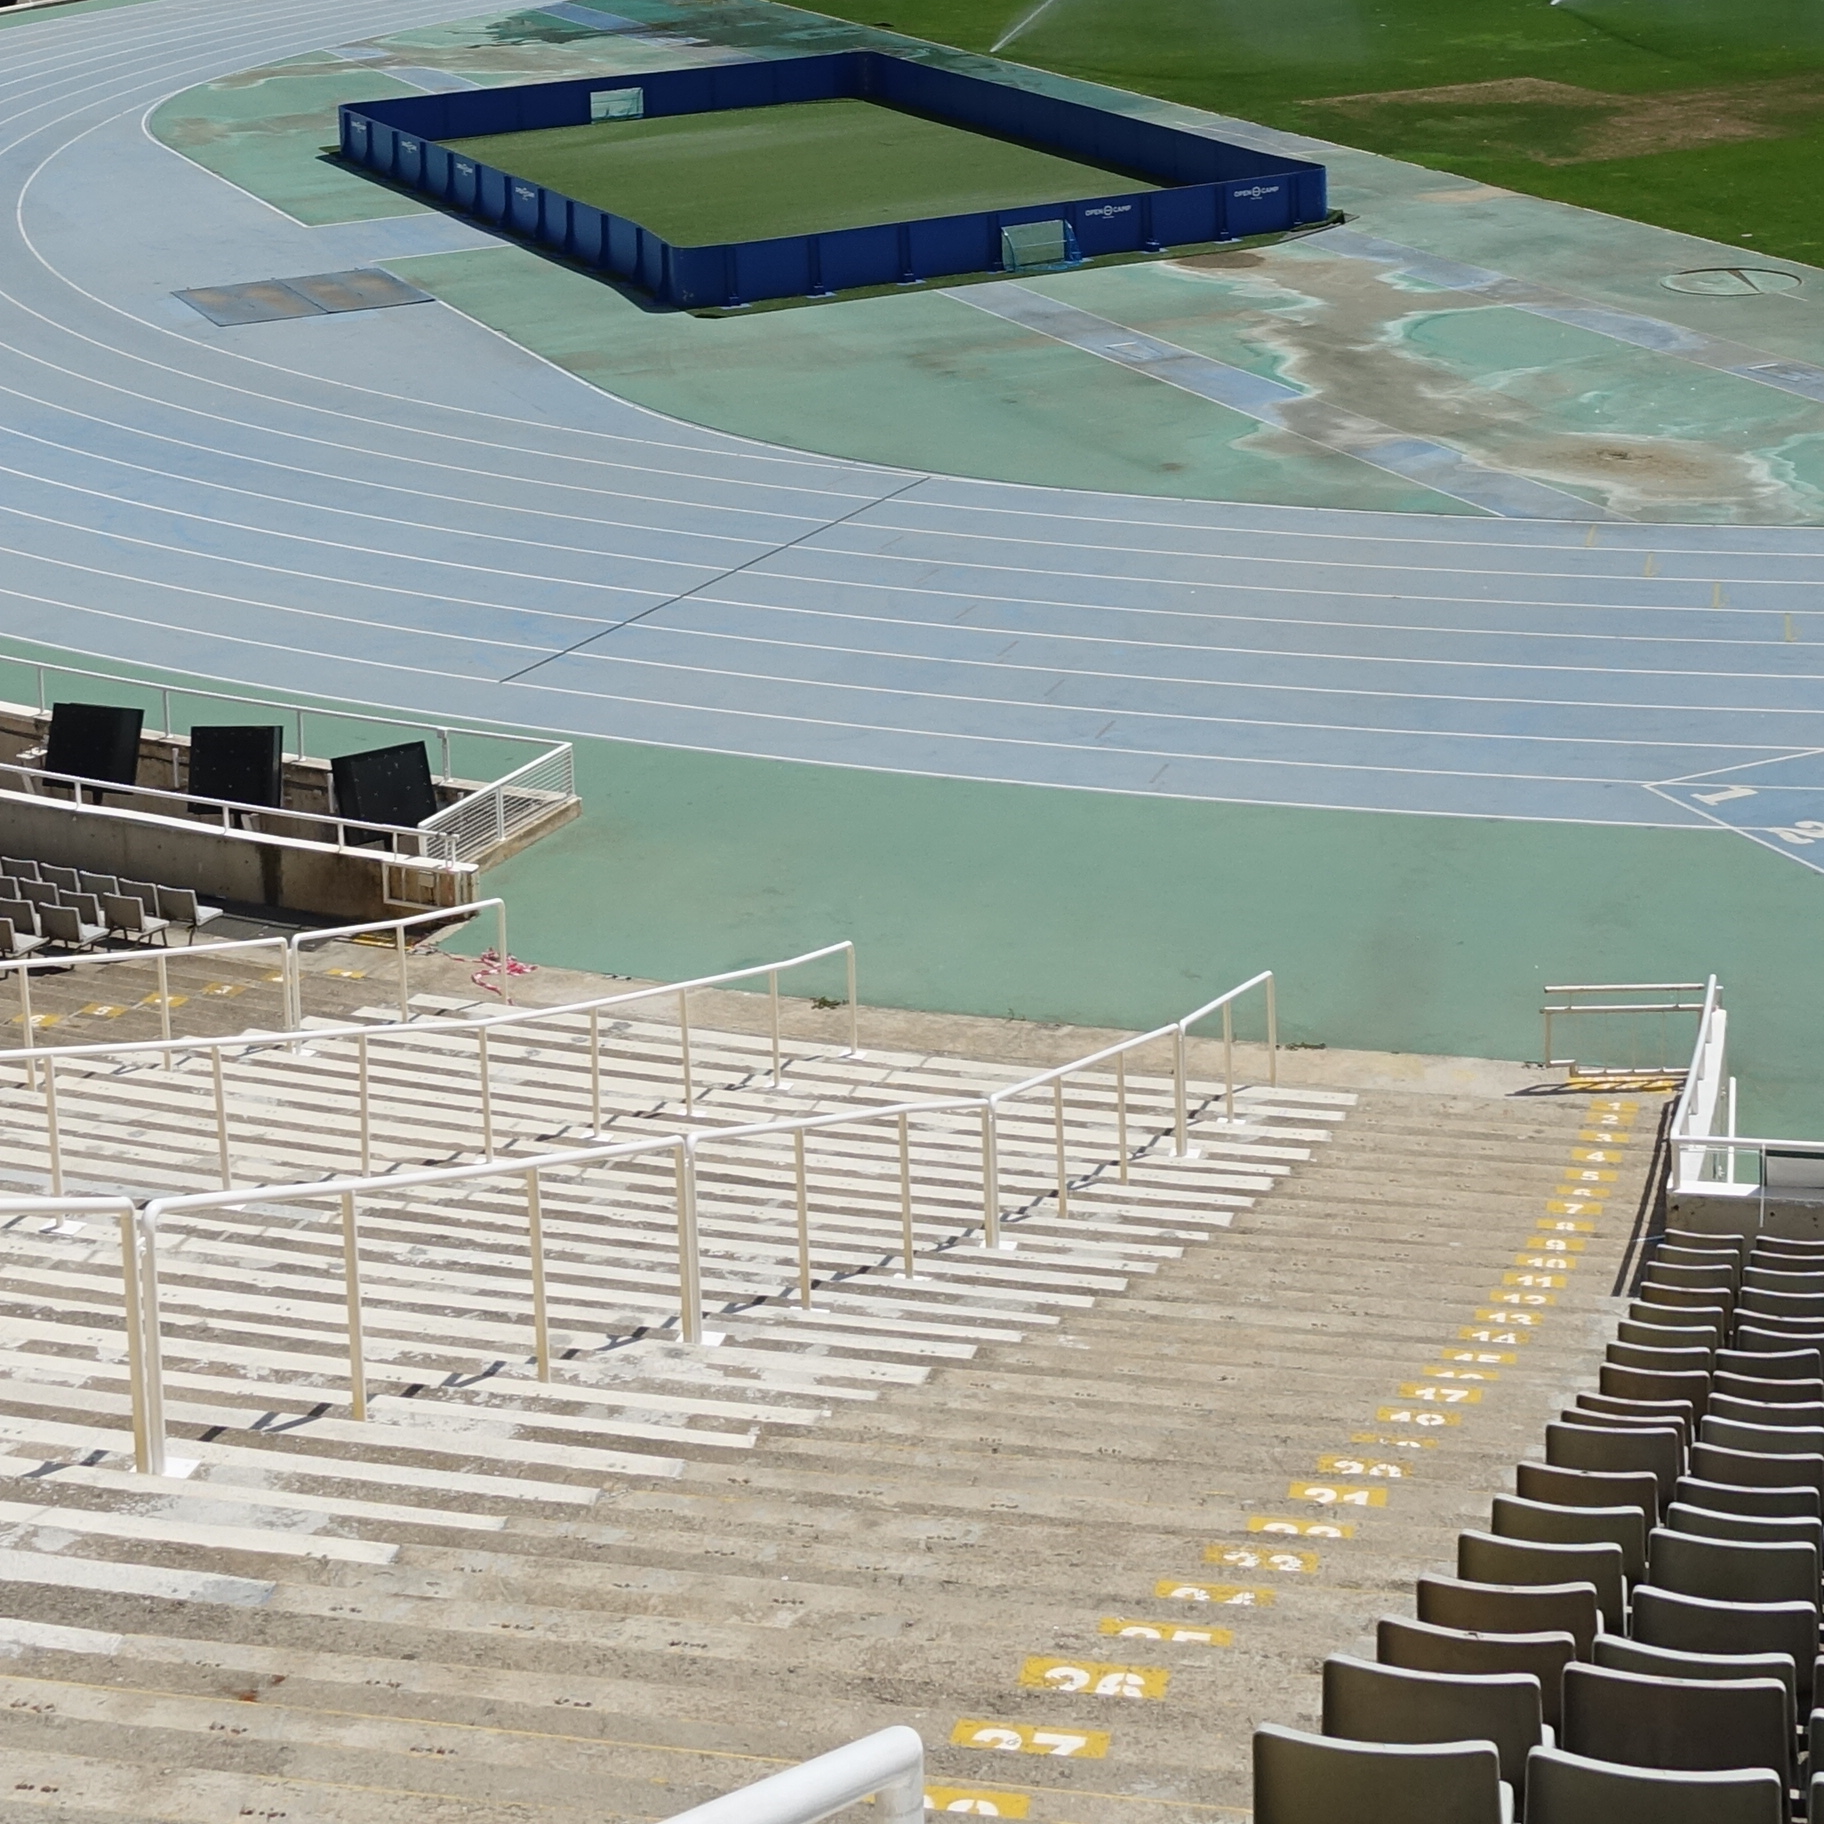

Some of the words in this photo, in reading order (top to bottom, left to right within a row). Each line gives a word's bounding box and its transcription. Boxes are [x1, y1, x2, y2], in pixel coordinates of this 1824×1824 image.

[1690, 785, 1758, 806] 1
[1608, 1102, 1621, 1111] 1
[1601, 1114, 1619, 1125] 2
[1586, 1151, 1606, 1162] 4
[1579, 1170, 1600, 1181] 5
[1564, 1203, 1584, 1214] 7
[1545, 1239, 1567, 1251] 9
[1517, 1275, 1553, 1288] 11
[1471, 1331, 1517, 1344] 14
[1415, 1387, 1469, 1402] 17
